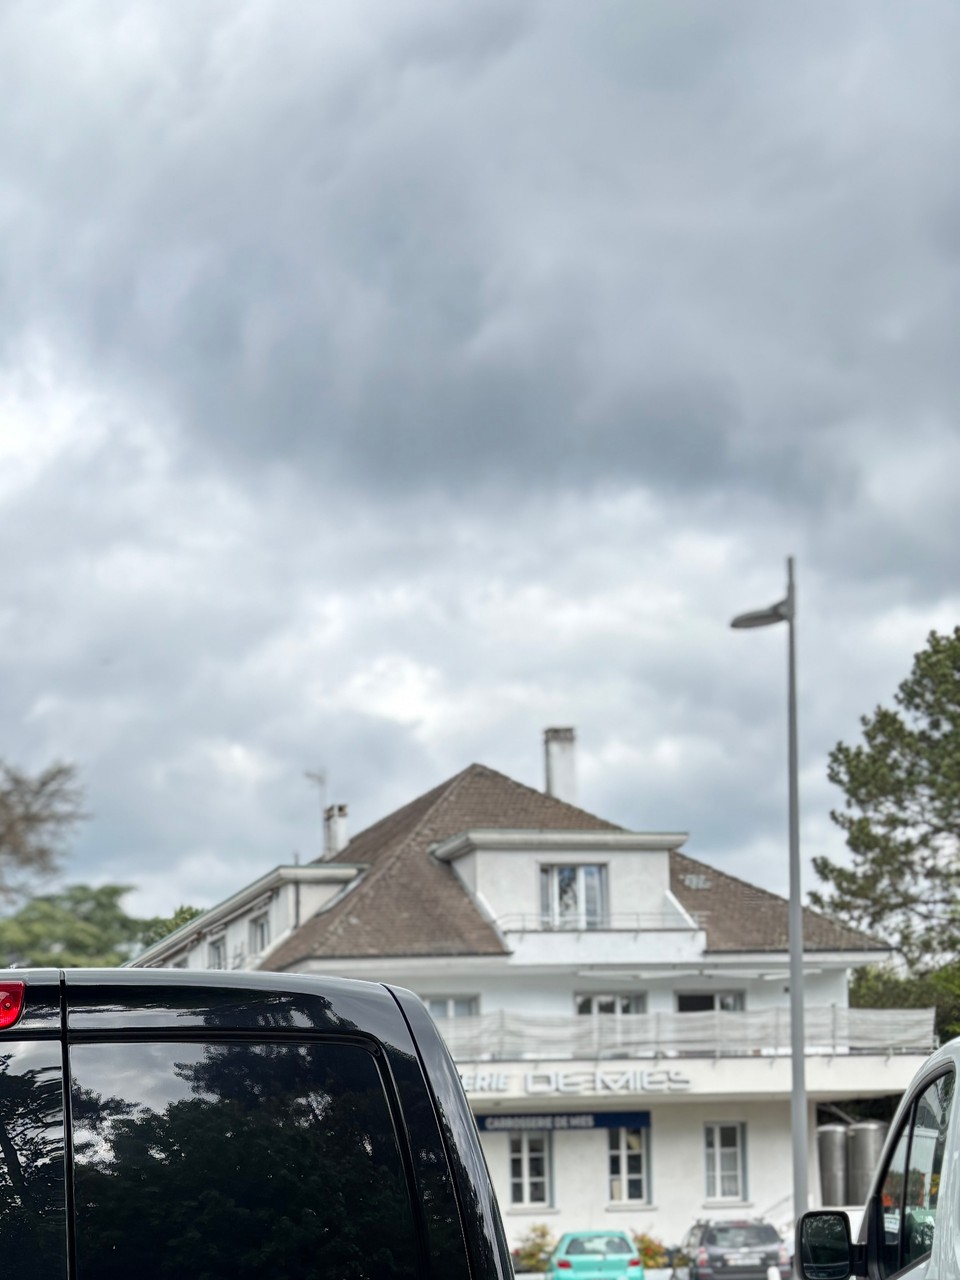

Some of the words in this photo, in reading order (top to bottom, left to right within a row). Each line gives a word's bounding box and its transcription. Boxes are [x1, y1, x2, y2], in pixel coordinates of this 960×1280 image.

[524, 1071, 582, 1095] DE
[594, 1070, 693, 1092] MIES
[554, 1115, 569, 1128] DE
